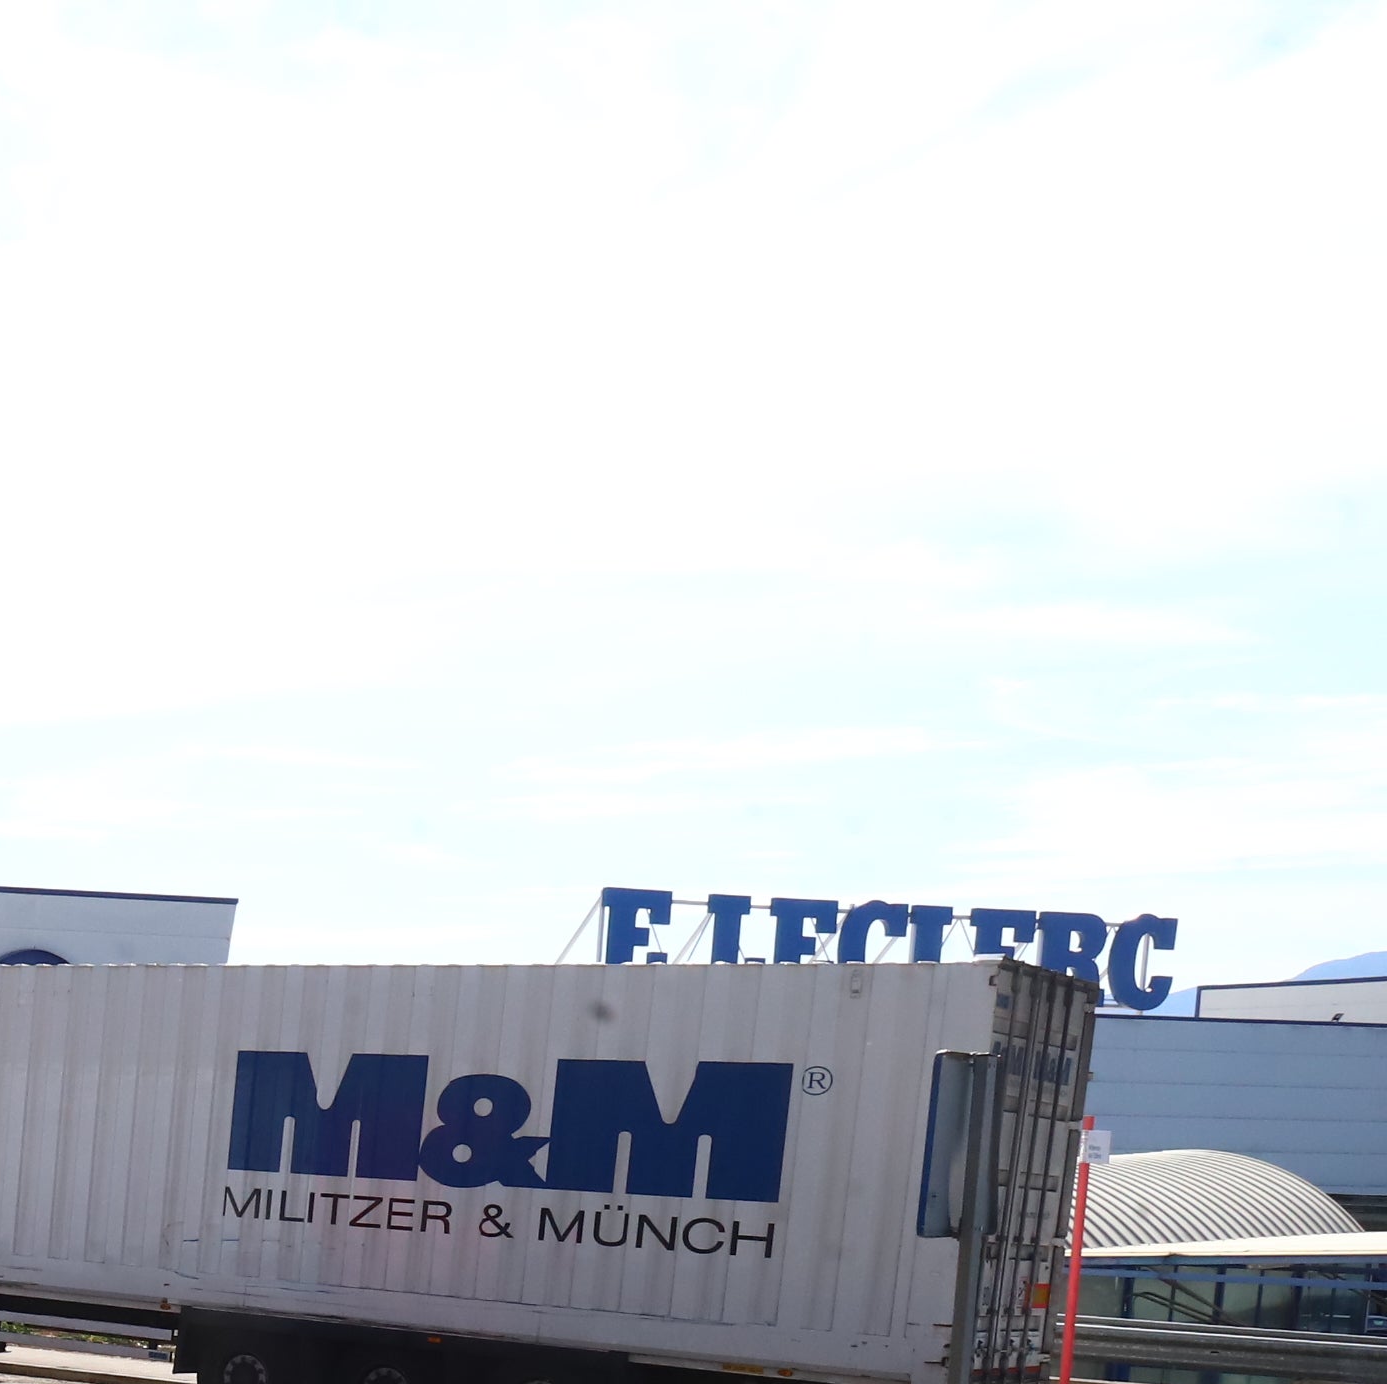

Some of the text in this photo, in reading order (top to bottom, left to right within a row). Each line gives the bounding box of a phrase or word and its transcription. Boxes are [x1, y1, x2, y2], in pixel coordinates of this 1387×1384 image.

[227, 1050, 794, 1203] M&M
[222, 1186, 776, 1259] MILITZER & MÜNCH
